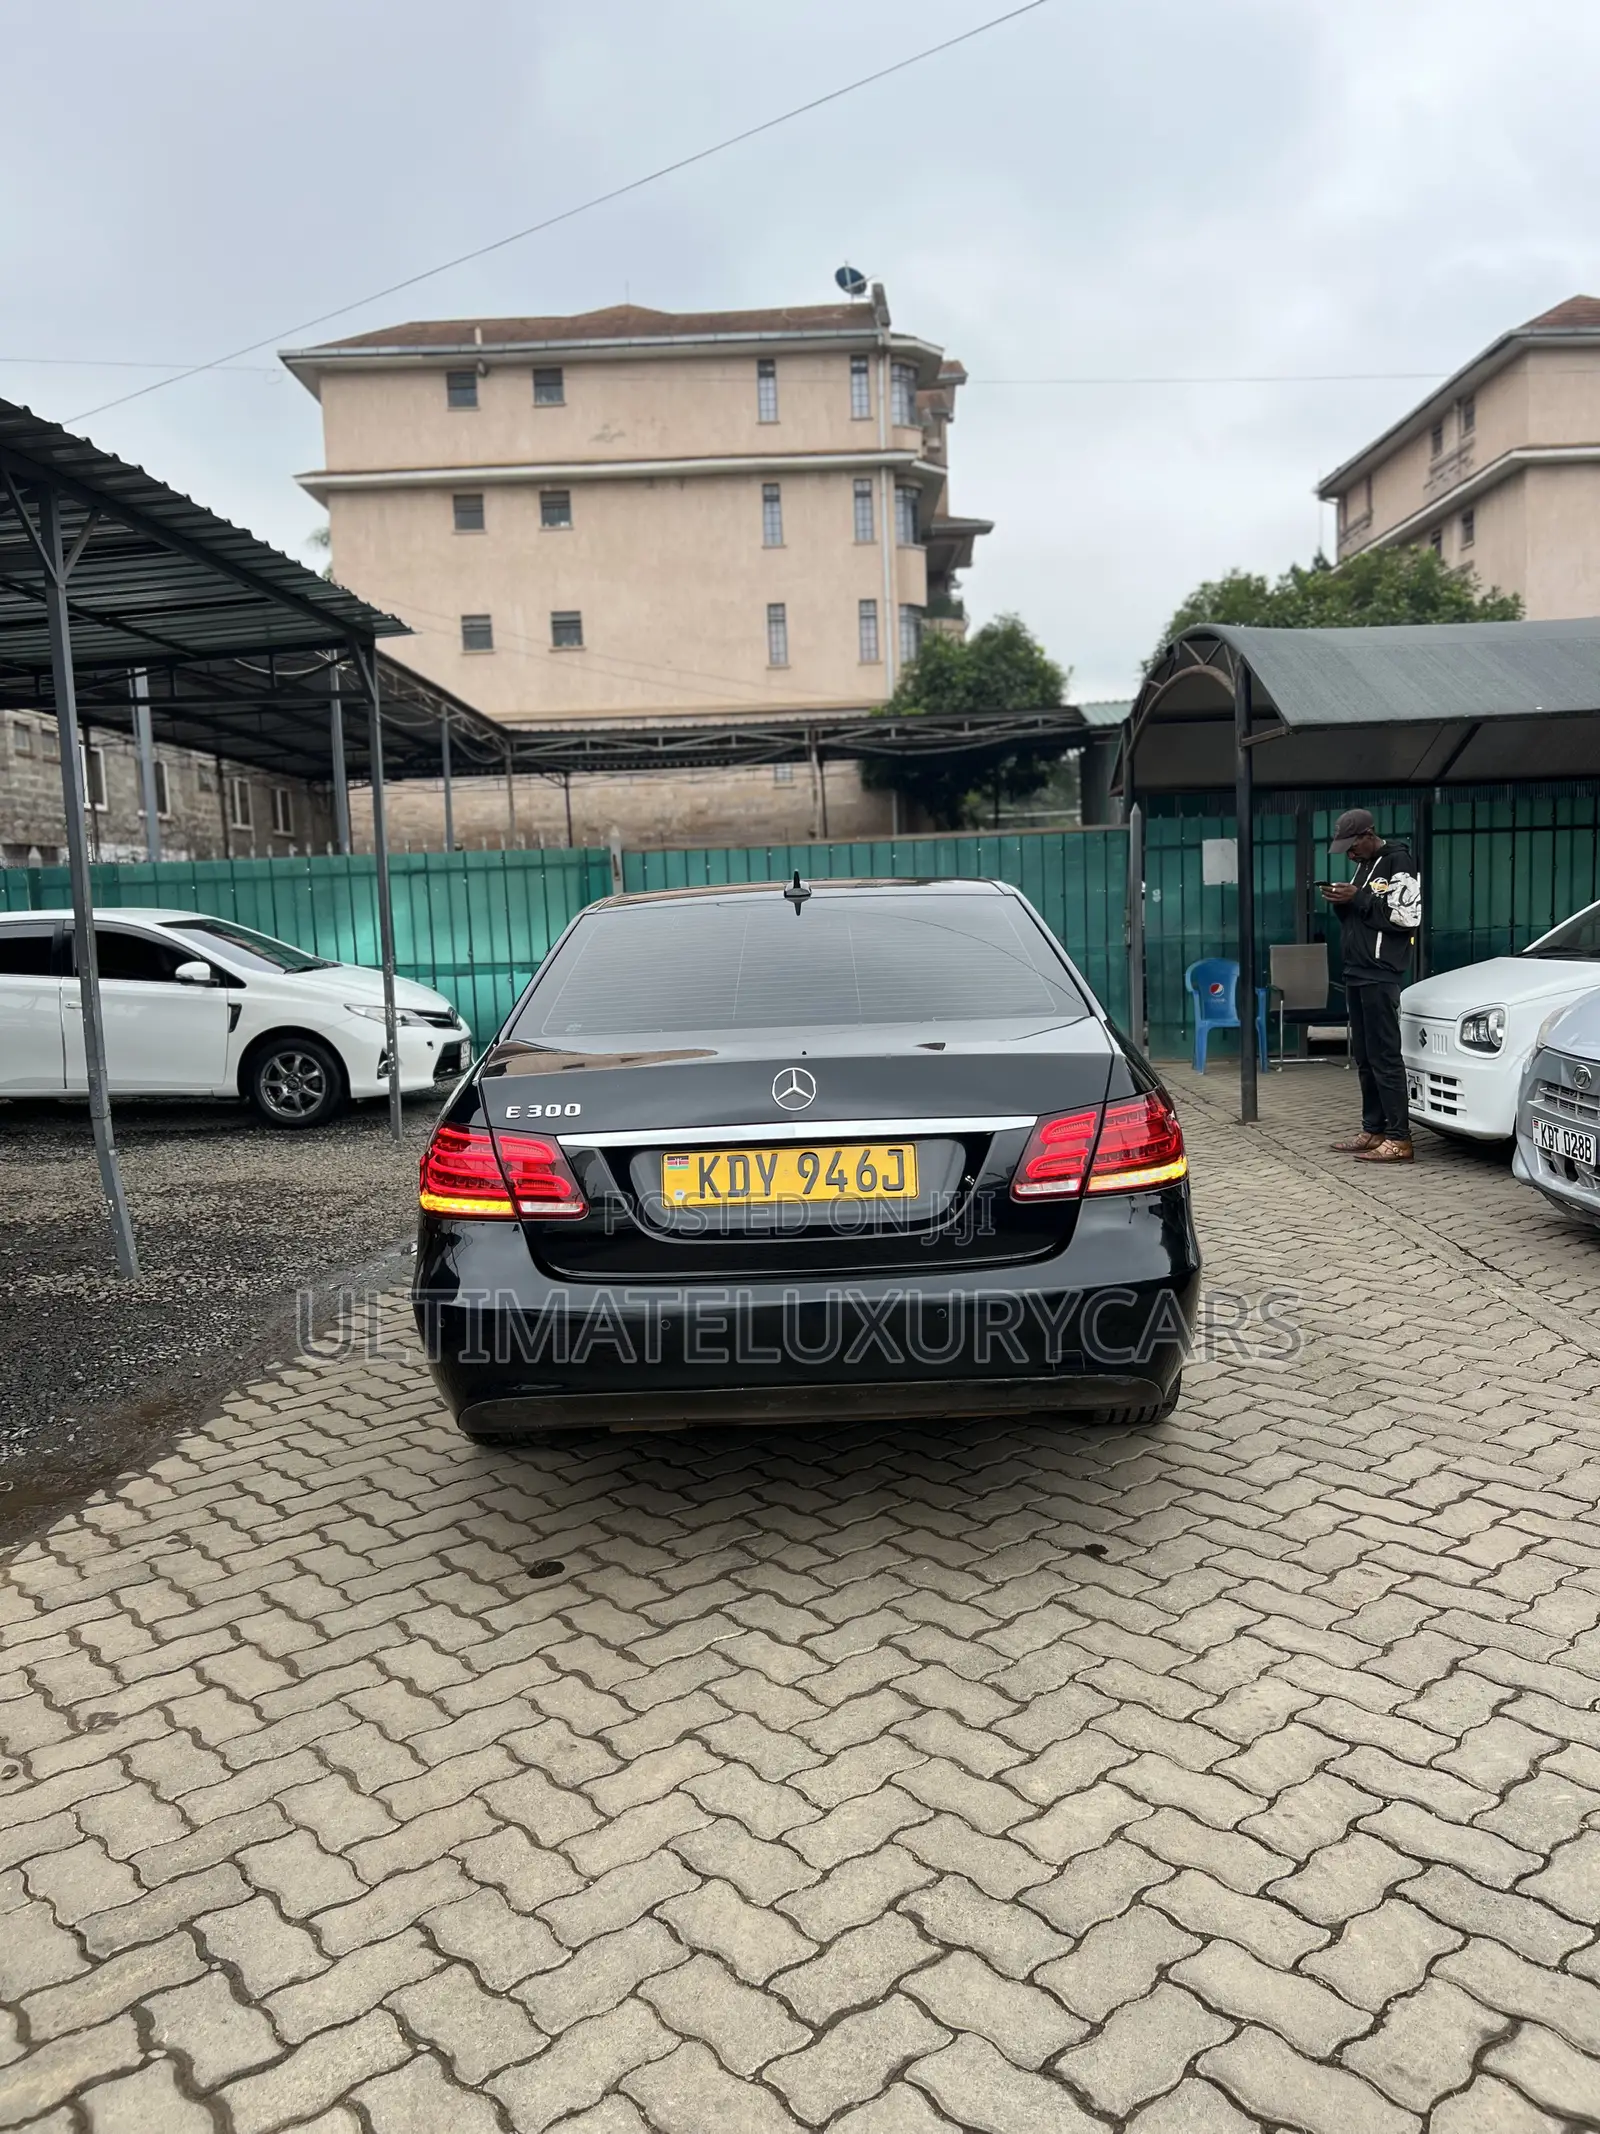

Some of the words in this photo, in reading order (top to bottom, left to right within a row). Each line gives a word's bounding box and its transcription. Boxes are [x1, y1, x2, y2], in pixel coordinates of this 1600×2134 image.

[505, 1105, 521, 1119] E
[526, 1103, 581, 1118] 300
[698, 1153, 778, 1199] KDY
[797, 1148, 904, 1195] 946J
